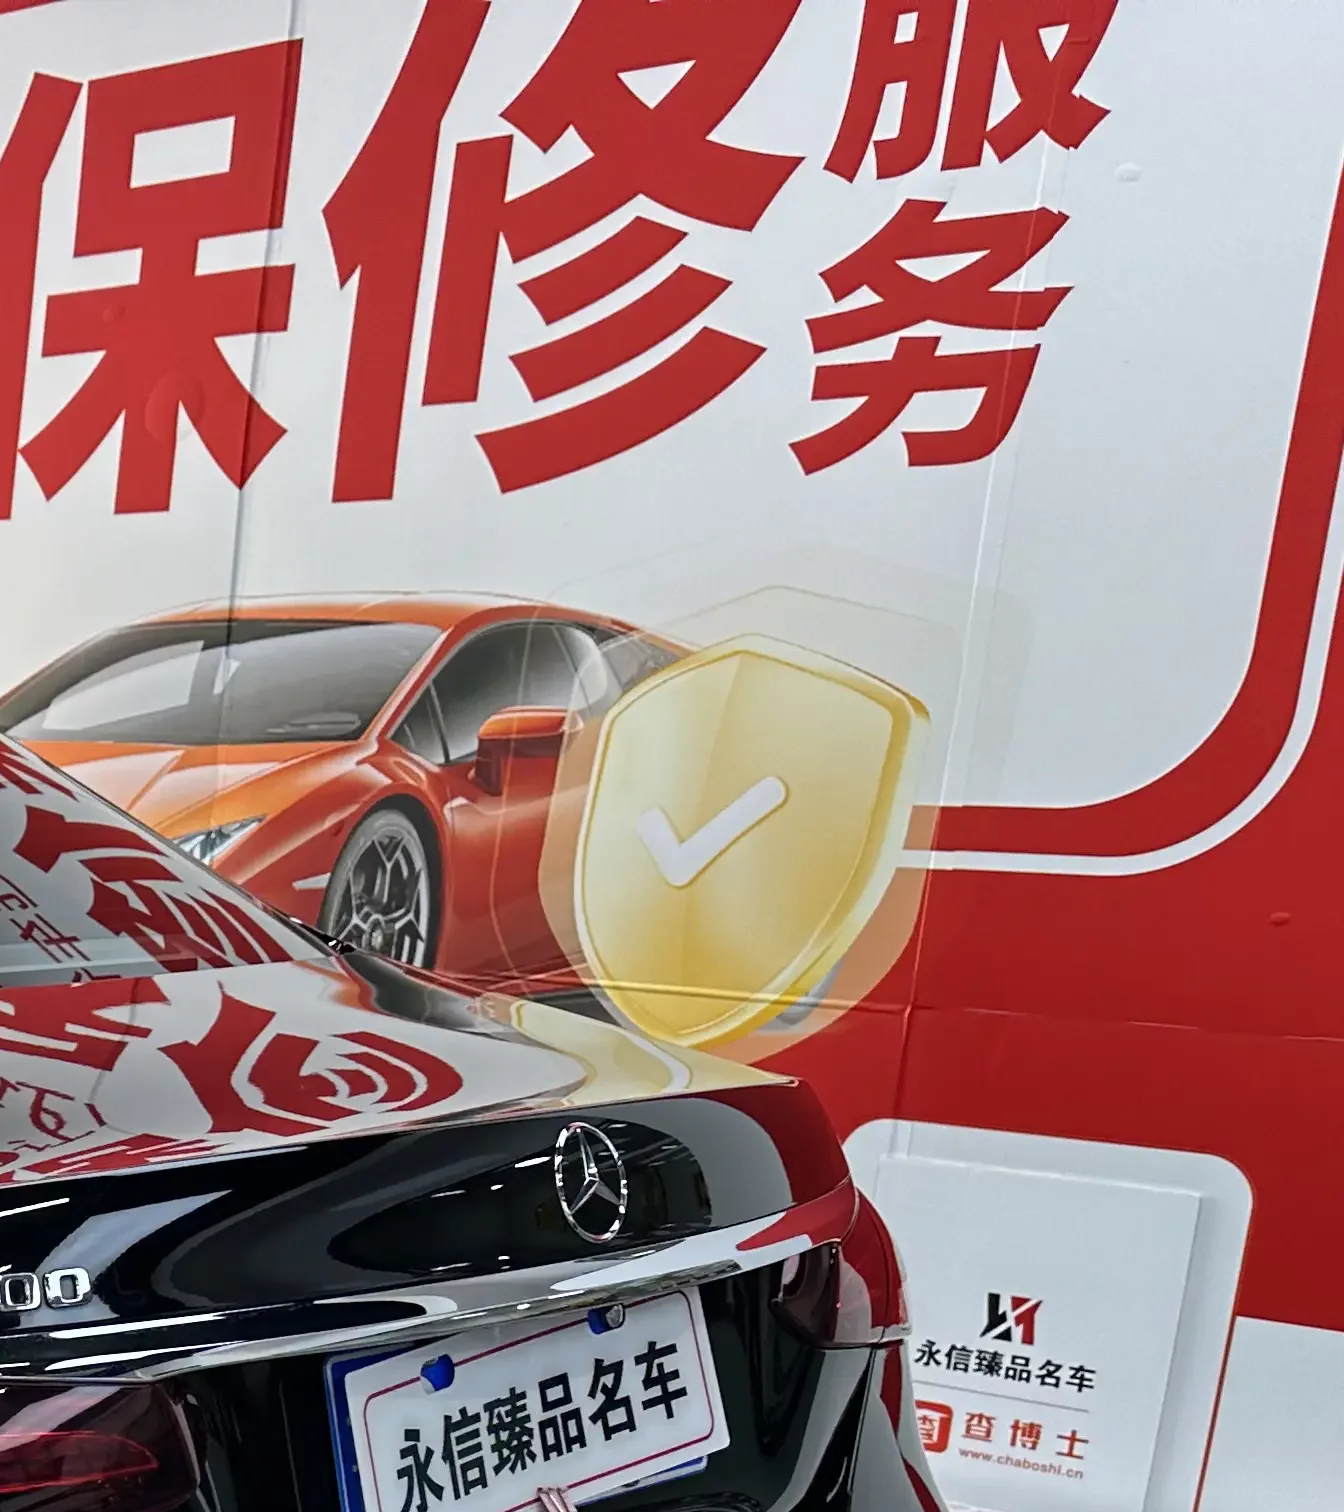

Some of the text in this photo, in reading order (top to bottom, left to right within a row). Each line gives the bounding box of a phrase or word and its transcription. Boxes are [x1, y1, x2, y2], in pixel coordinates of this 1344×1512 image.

[914, 1339, 1097, 1393] 永信臻品名车
[961, 1411, 1090, 1461] 查博士
[958, 1447, 1084, 1480] www.chaboshi.cn
